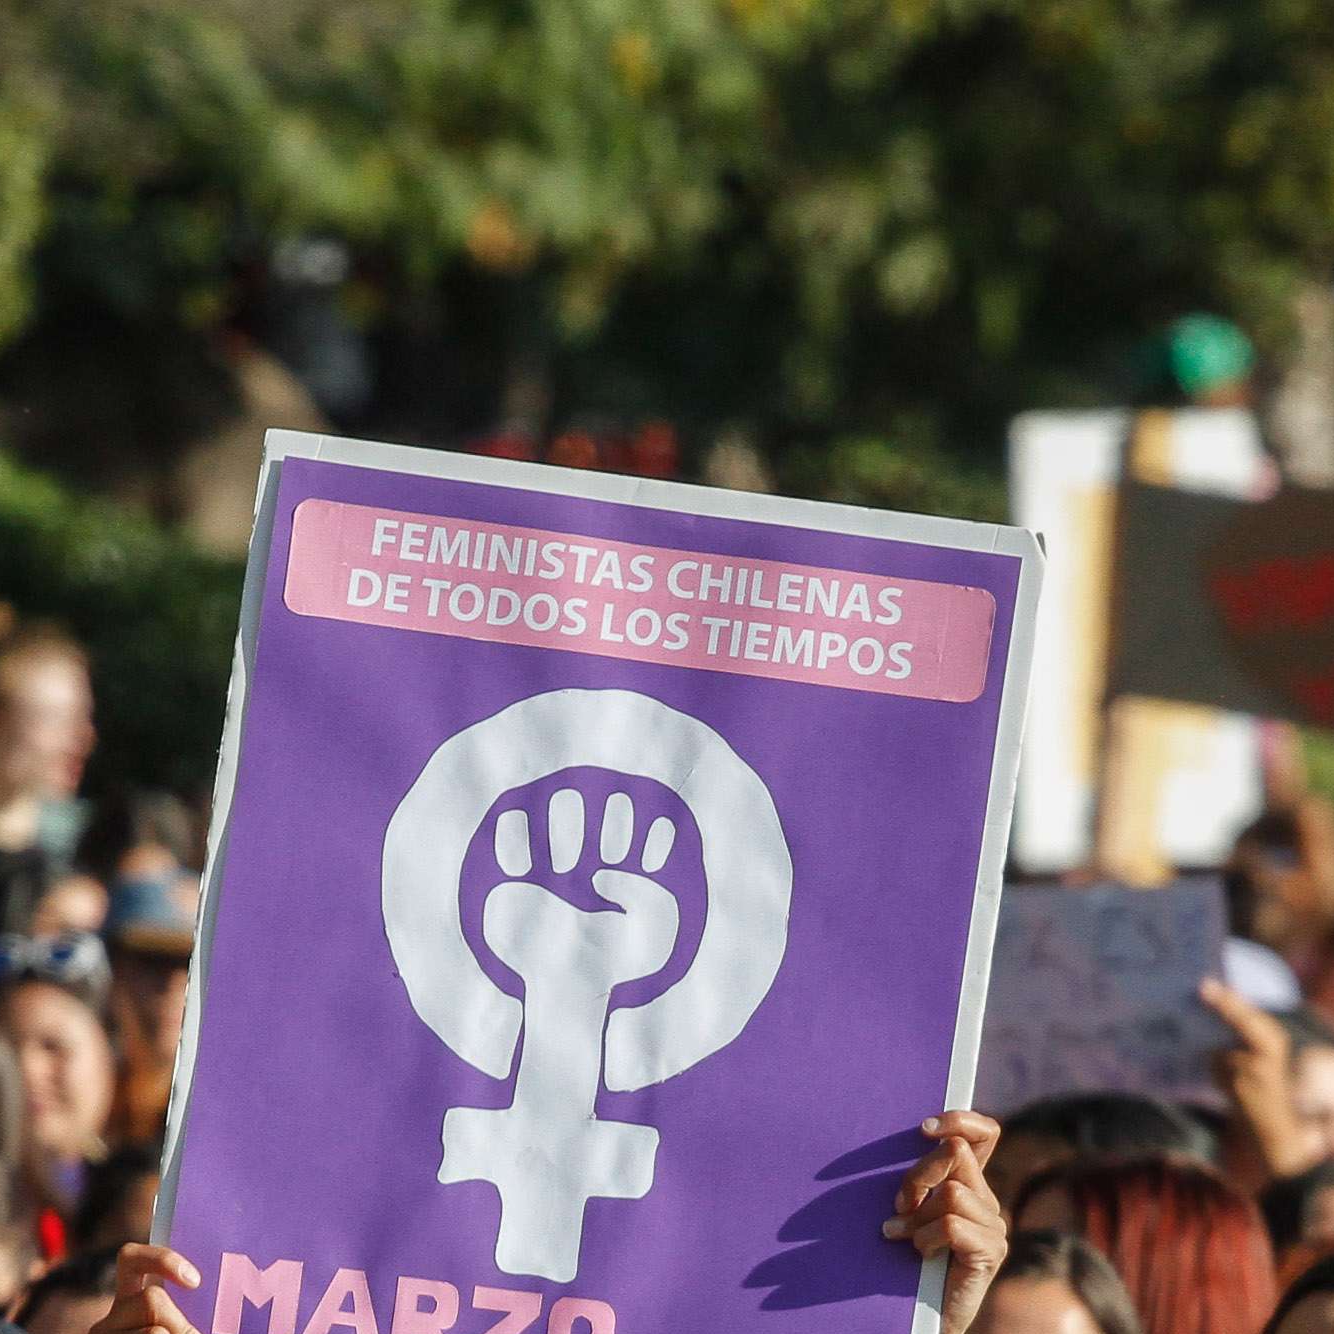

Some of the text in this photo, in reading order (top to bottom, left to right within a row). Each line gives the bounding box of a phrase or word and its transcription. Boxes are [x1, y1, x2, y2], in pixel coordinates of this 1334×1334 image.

[346, 568, 913, 681] DE TODOS LOS TIEMPOS
[371, 518, 903, 626] FEMINISTAS CHILENAS
